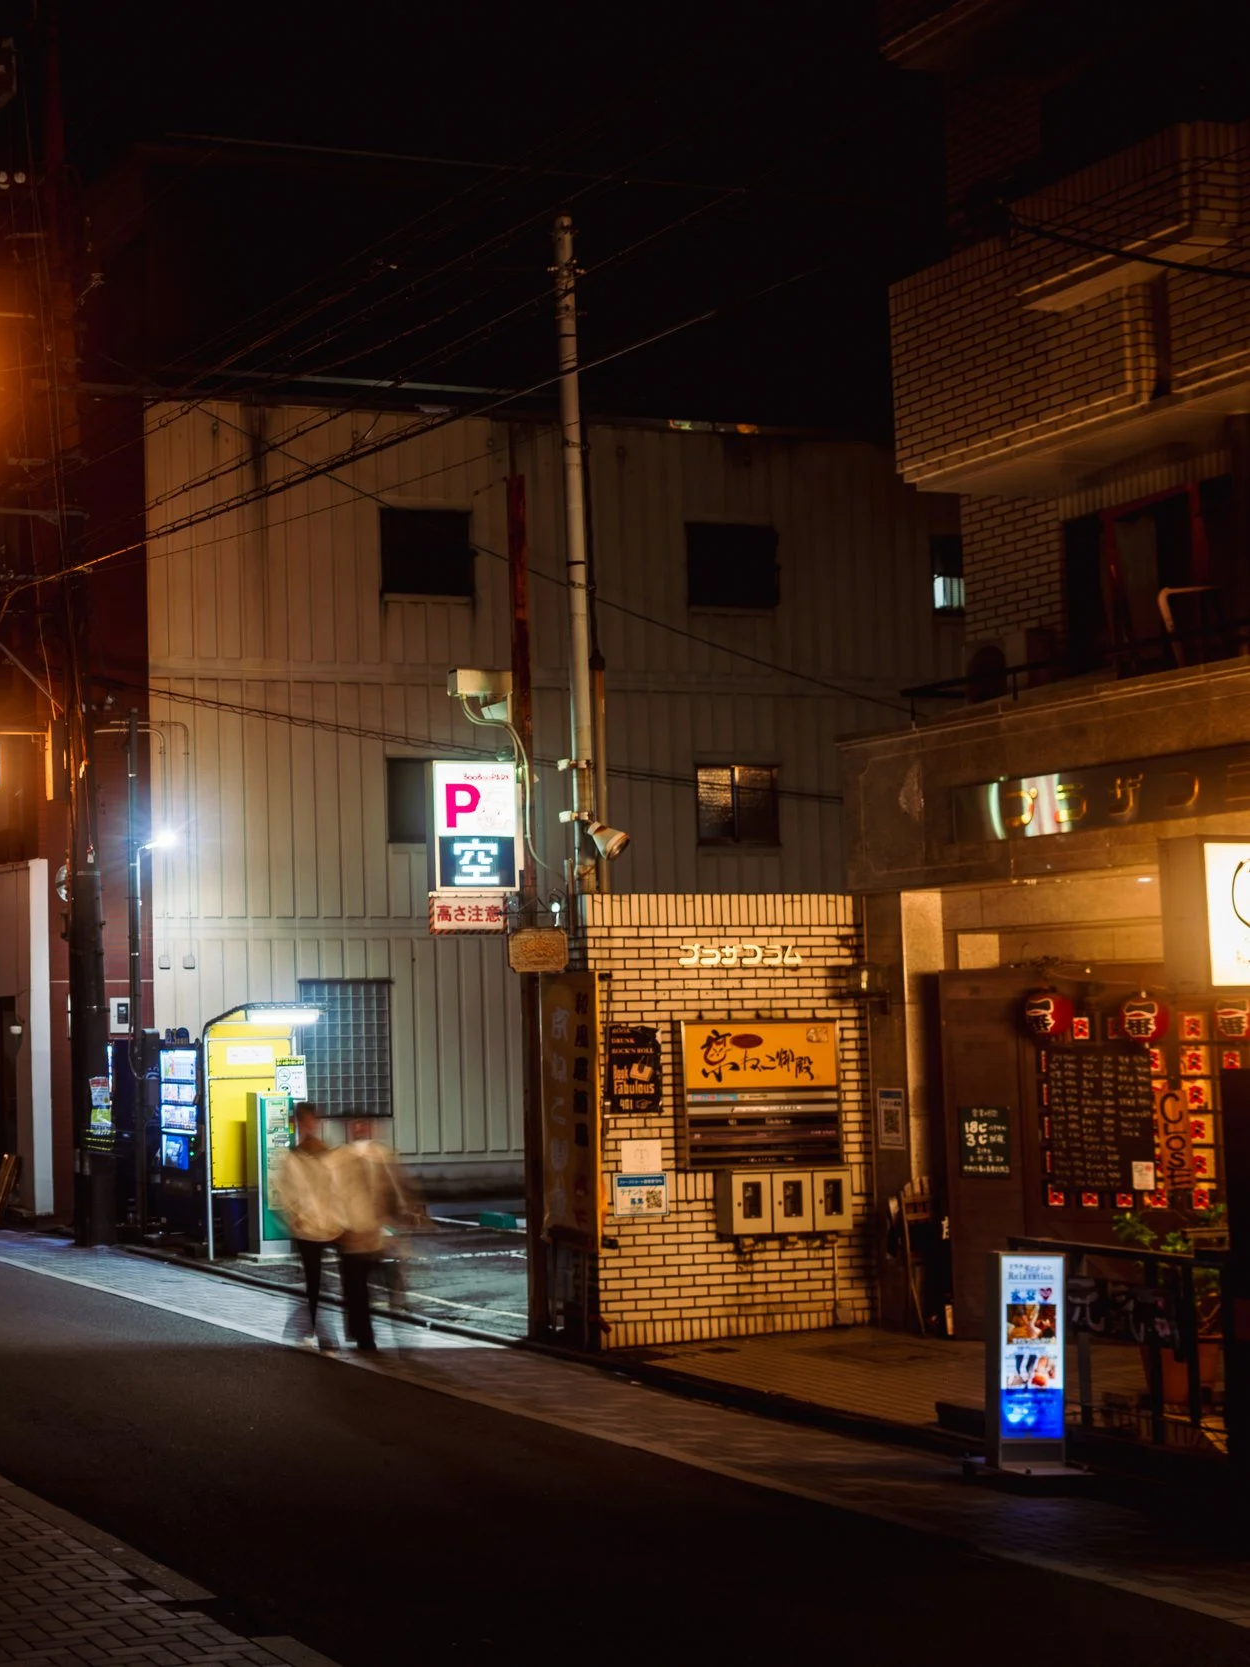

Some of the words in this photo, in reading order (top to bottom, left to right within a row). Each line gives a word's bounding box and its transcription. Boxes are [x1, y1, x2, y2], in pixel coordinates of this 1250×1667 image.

[445, 783, 481, 829] P
[453, 838, 500, 886] 空
[436, 904, 503, 923] 高さ注意
[678, 943, 803, 966] プラザコラム
[613, 1079, 655, 1095] Fabulous
